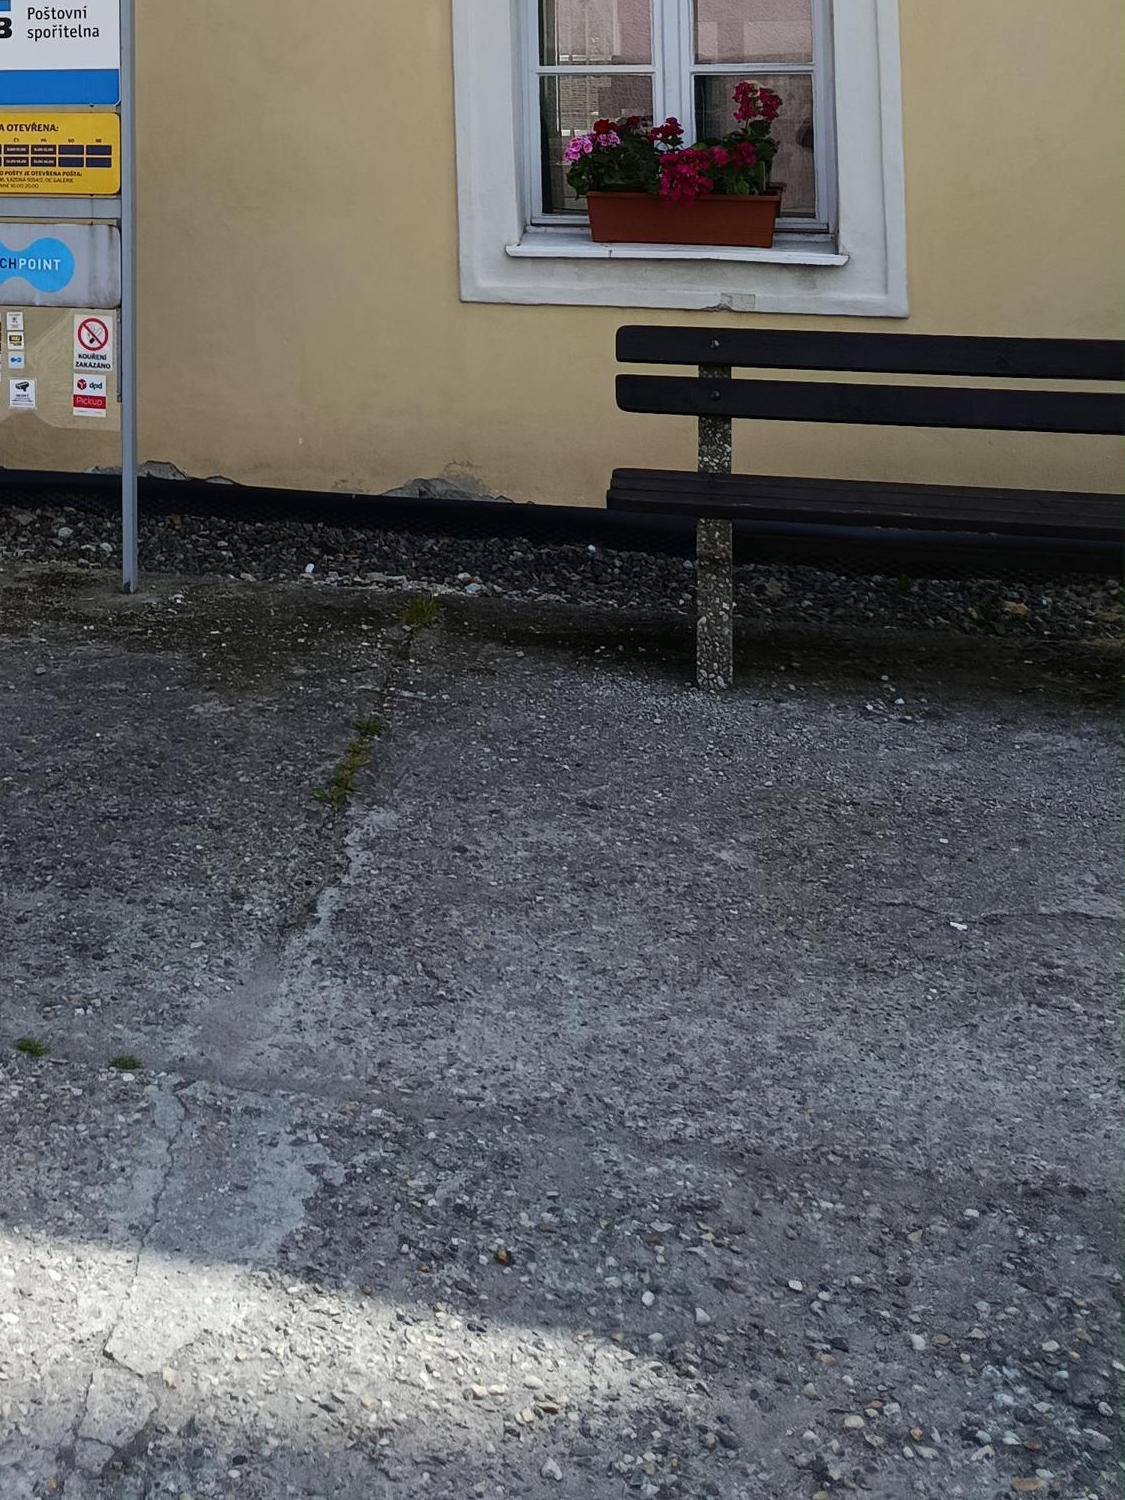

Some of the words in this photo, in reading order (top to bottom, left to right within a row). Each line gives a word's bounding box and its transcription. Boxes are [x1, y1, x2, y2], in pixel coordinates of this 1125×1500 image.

[27, 5, 88, 21] Poštovní
[27, 24, 100, 42] spořitelna
[6, 122, 59, 132] OTEVŘENA:
[75, 361, 111, 369] ZAKÁZÁNO
[89, 381, 103, 390] dpd
[76, 396, 103, 406] Pickup
